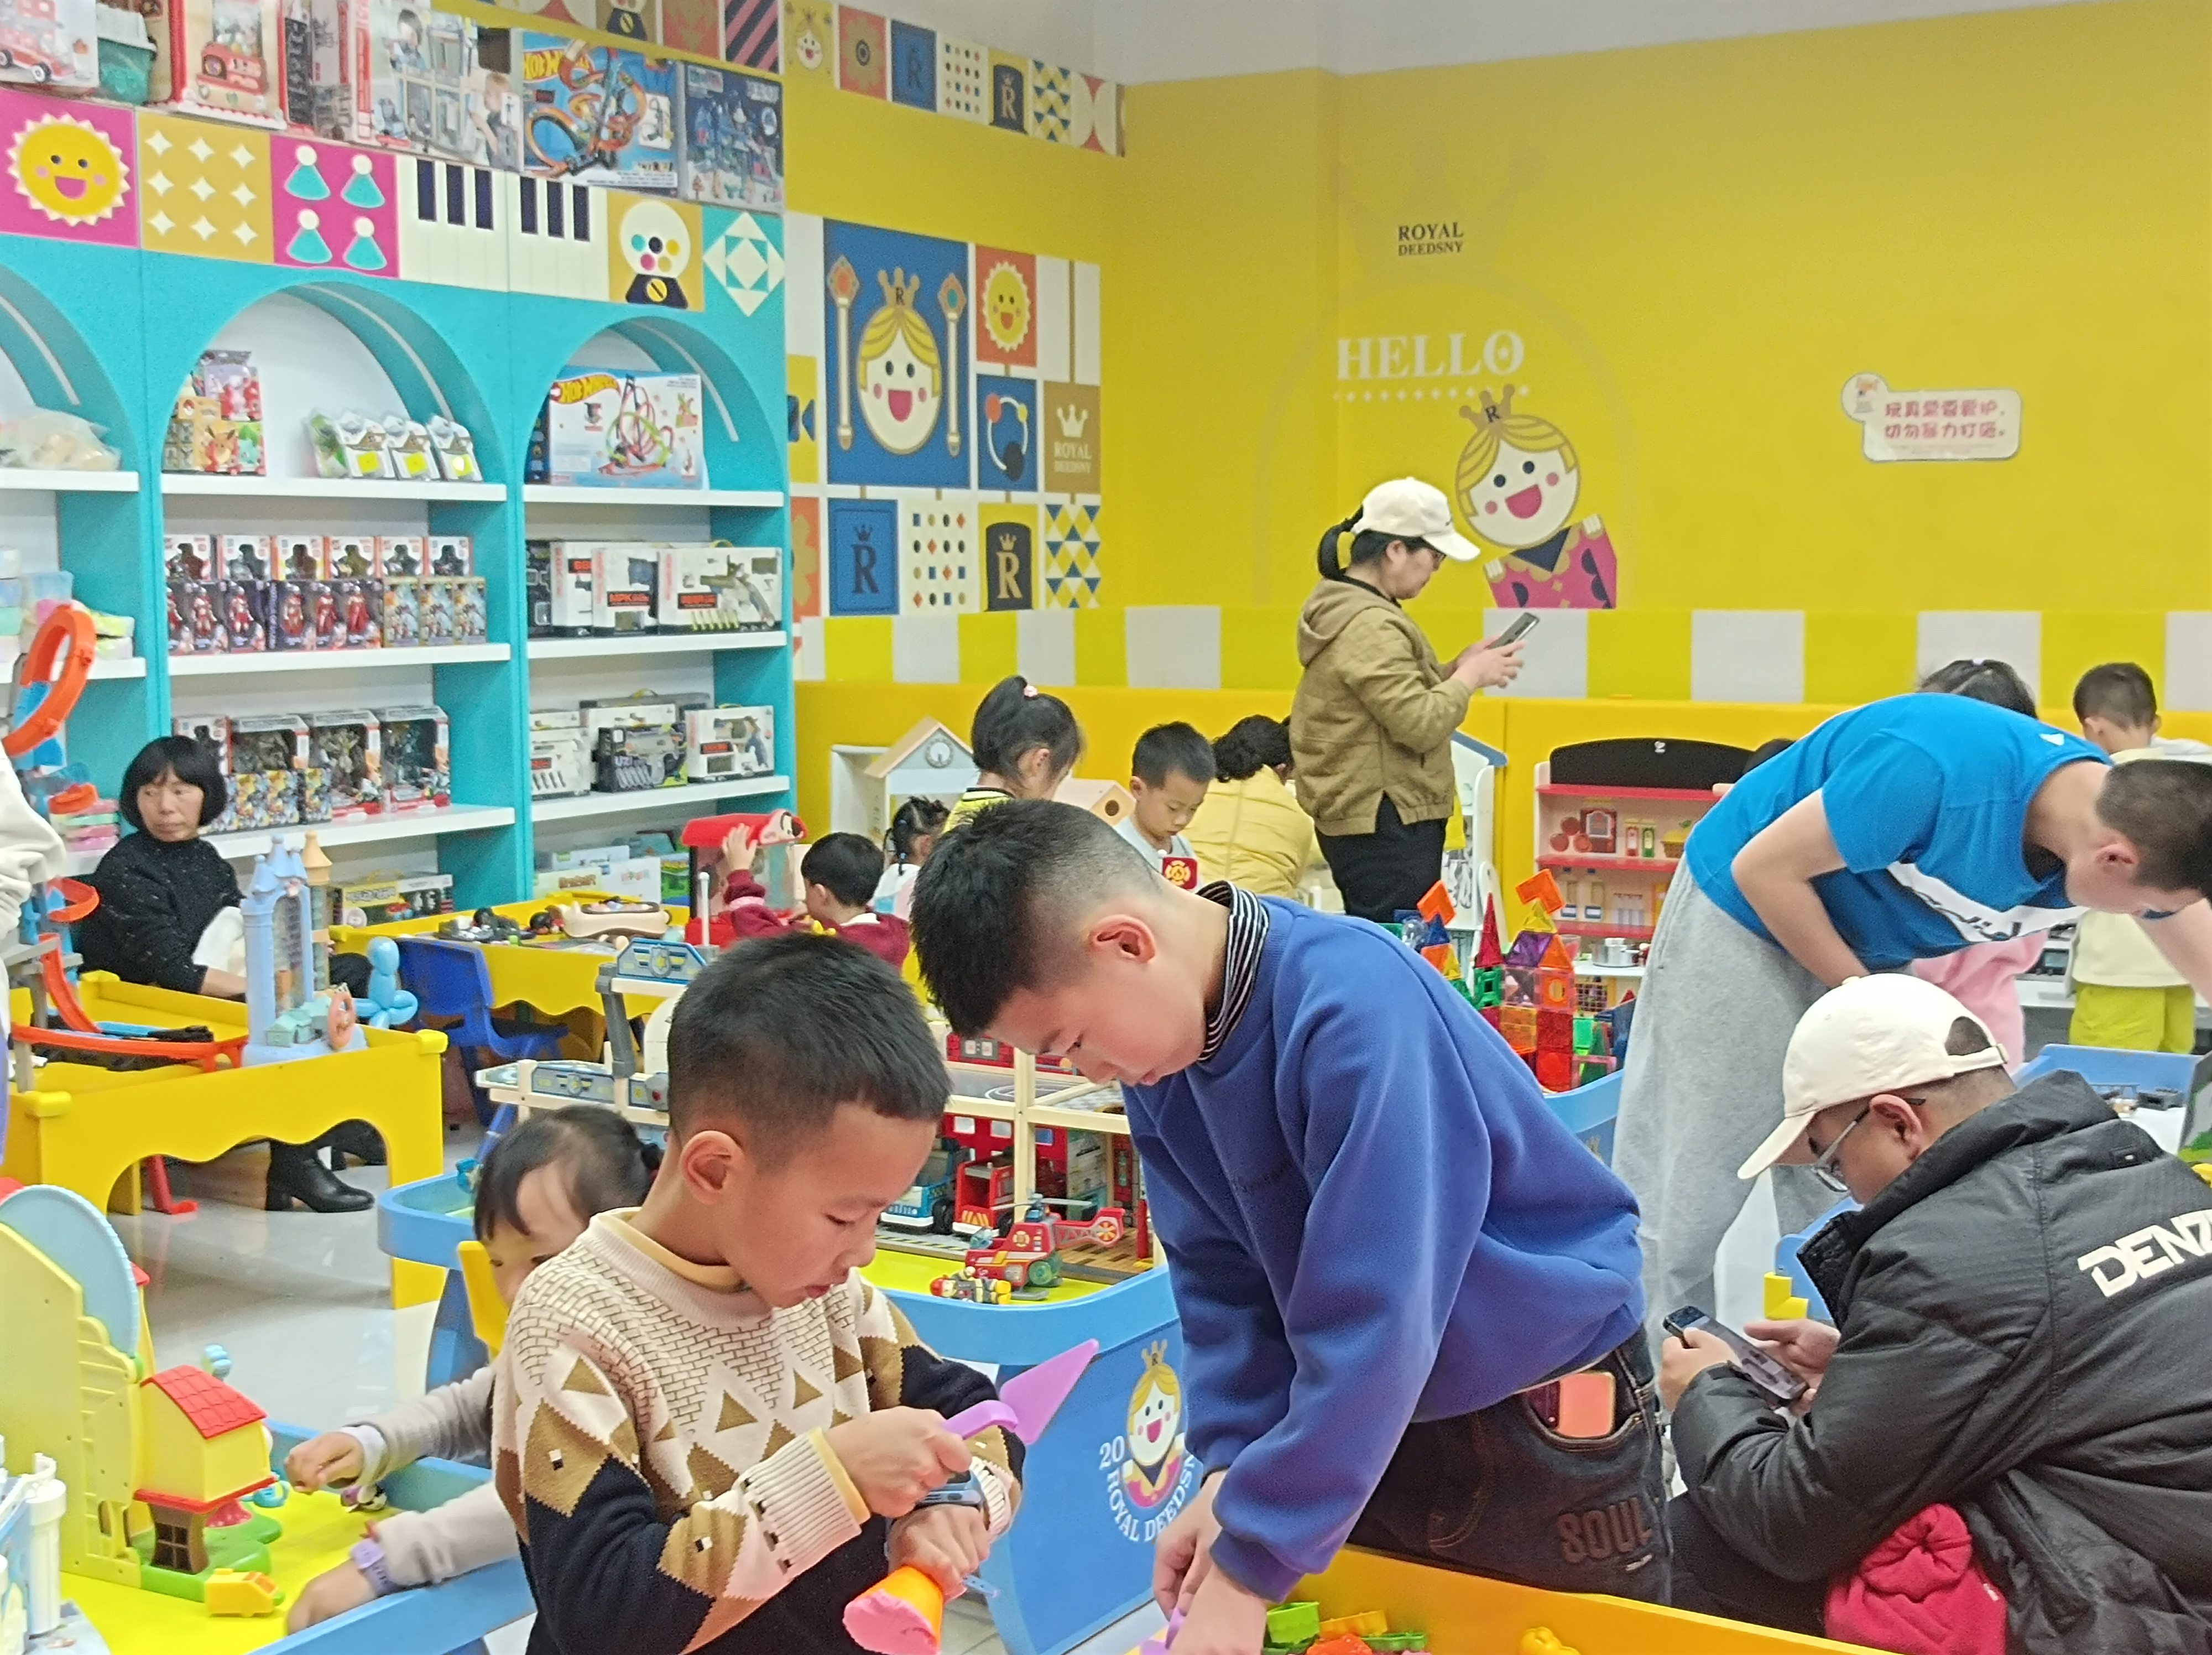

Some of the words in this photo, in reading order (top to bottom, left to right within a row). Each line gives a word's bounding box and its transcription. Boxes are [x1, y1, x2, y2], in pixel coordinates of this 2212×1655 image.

[1001, 85, 1017, 120] R
[1398, 222, 1464, 241] ROYAL
[1398, 241, 1463, 256] DEEDSNY
[895, 288, 906, 305] R
[1337, 330, 1525, 381] HELLO
[1485, 404, 1500, 424] R
[1054, 442, 1092, 459] ROYAL
[852, 544, 879, 594] R
[996, 551, 1021, 599] R
[1099, 1435, 1125, 1470] 20
[1107, 1467, 1140, 1542] ROYAL
